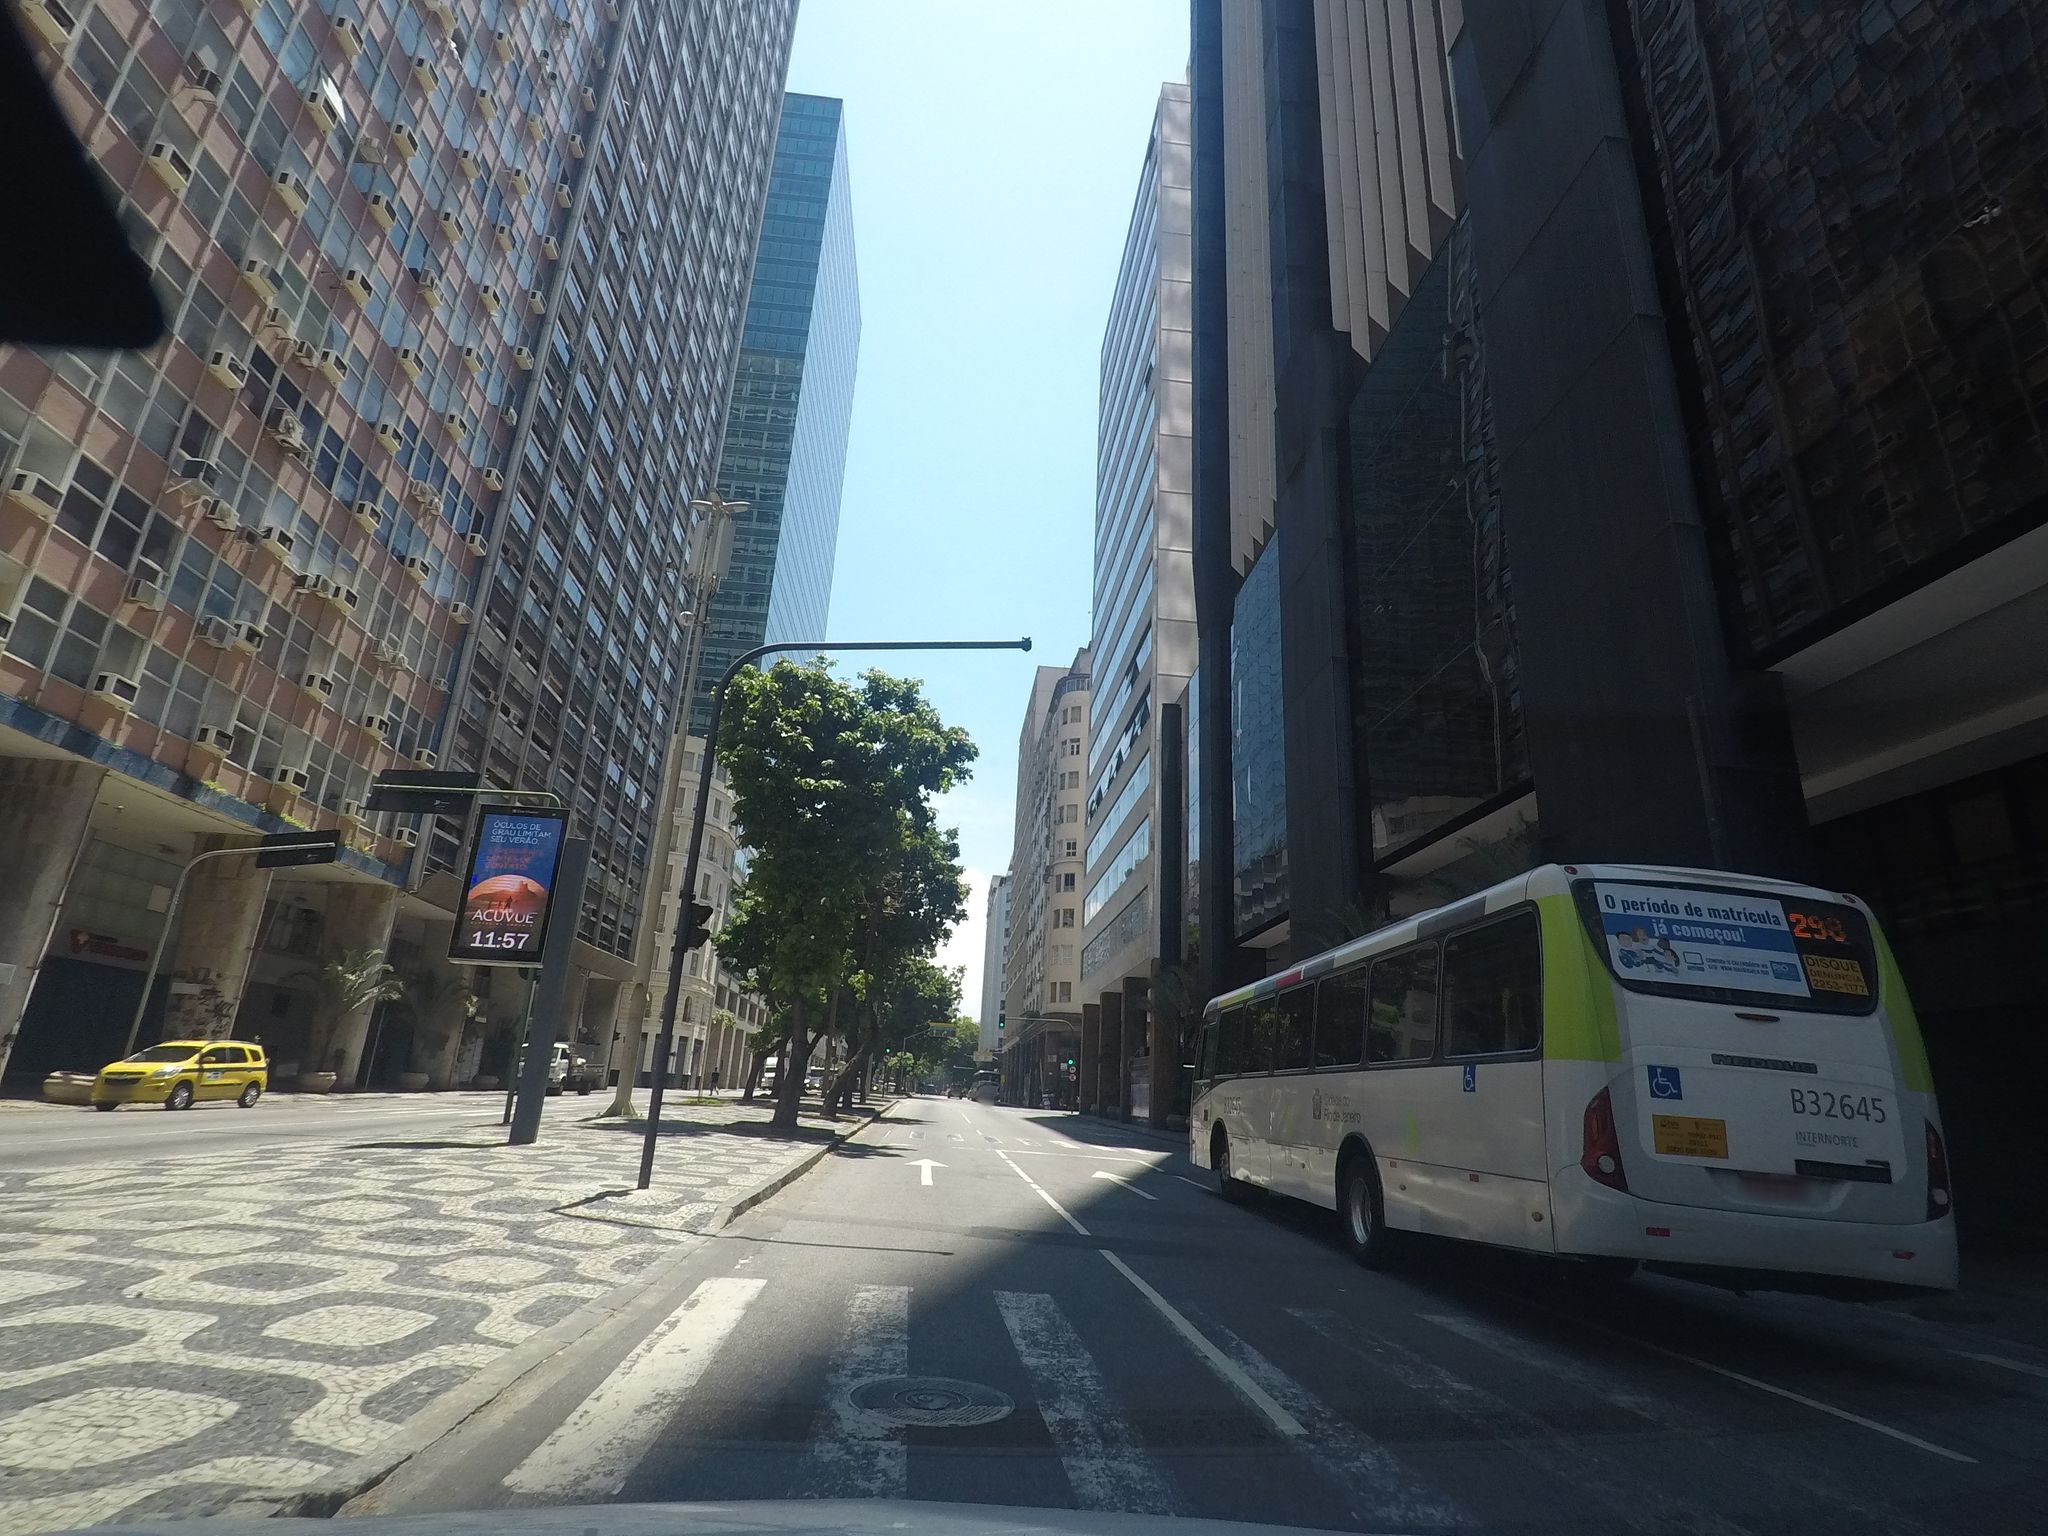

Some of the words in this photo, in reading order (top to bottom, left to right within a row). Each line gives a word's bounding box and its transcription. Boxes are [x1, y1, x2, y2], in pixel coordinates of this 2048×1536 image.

[492, 828, 517, 837] GRAU
[517, 830, 552, 839] LIMITAM
[493, 820, 528, 831] ÓCULOS
[529, 823, 542, 831] DE
[490, 835, 507, 843] SEU
[471, 909, 538, 924] ACUVUE
[1604, 894, 1616, 909] O
[1621, 897, 1680, 915] período
[1685, 902, 1703, 917] de
[1707, 906, 1781, 926] matrícula
[470, 930, 530, 949] 11:57
[1651, 919, 1668, 937] já
[1672, 923, 1747, 944] começou!
[1805, 957, 1860, 973] DISQUE
[1790, 1088, 1886, 1123] B32645
[1795, 1131, 1859, 1148] INTERNORTE
